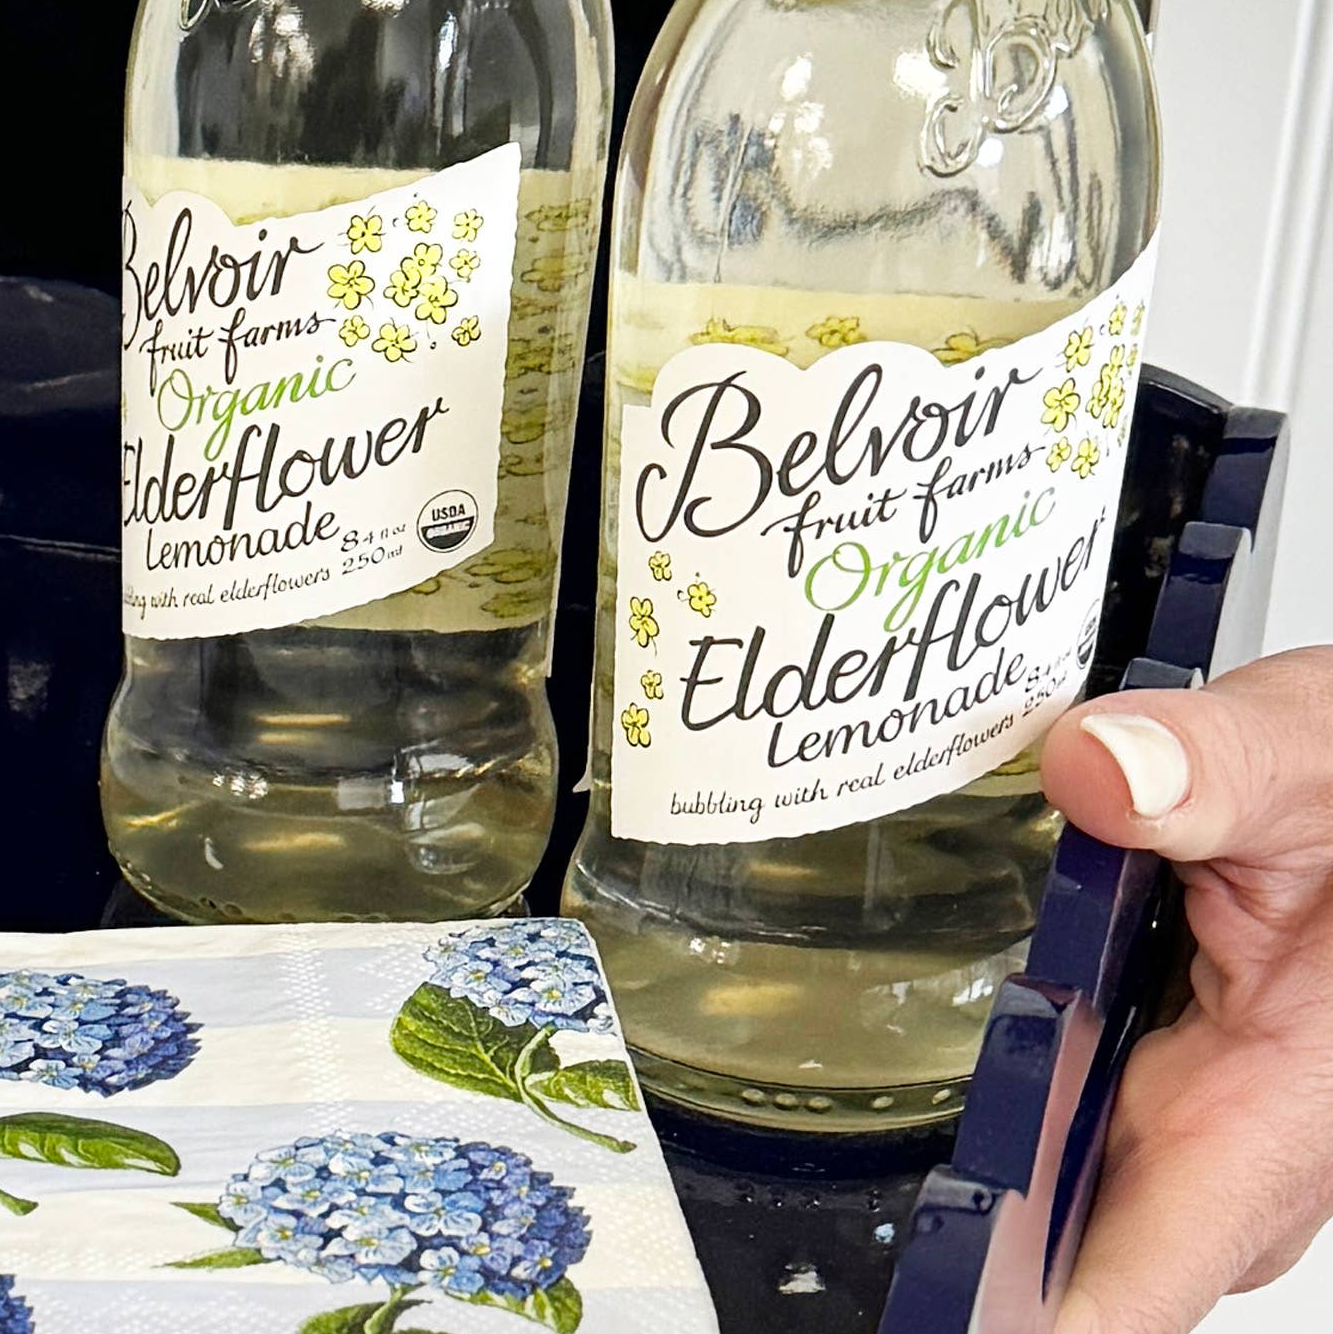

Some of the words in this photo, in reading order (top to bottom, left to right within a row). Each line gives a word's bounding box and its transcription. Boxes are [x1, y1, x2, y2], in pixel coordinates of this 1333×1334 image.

[139, 319, 215, 397] fruit
[217, 307, 337, 386] farms
[157, 355, 357, 462] Organic
[635, 363, 1043, 543] Belvoir
[761, 490, 907, 578] fruit
[915, 443, 1047, 543] farms
[431, 503, 466, 522] USDA
[804, 486, 1057, 633] Organic
[182, 583, 215, 607] real
[219, 565, 331, 604] elderflowers
[680, 505, 1106, 731] Elderflower
[767, 646, 1028, 768] Lemonade
[670, 790, 766, 824] bubbling
[774, 778, 830, 810] with
[836, 762, 887, 798] real
[893, 714, 1015, 779] elderflowers
